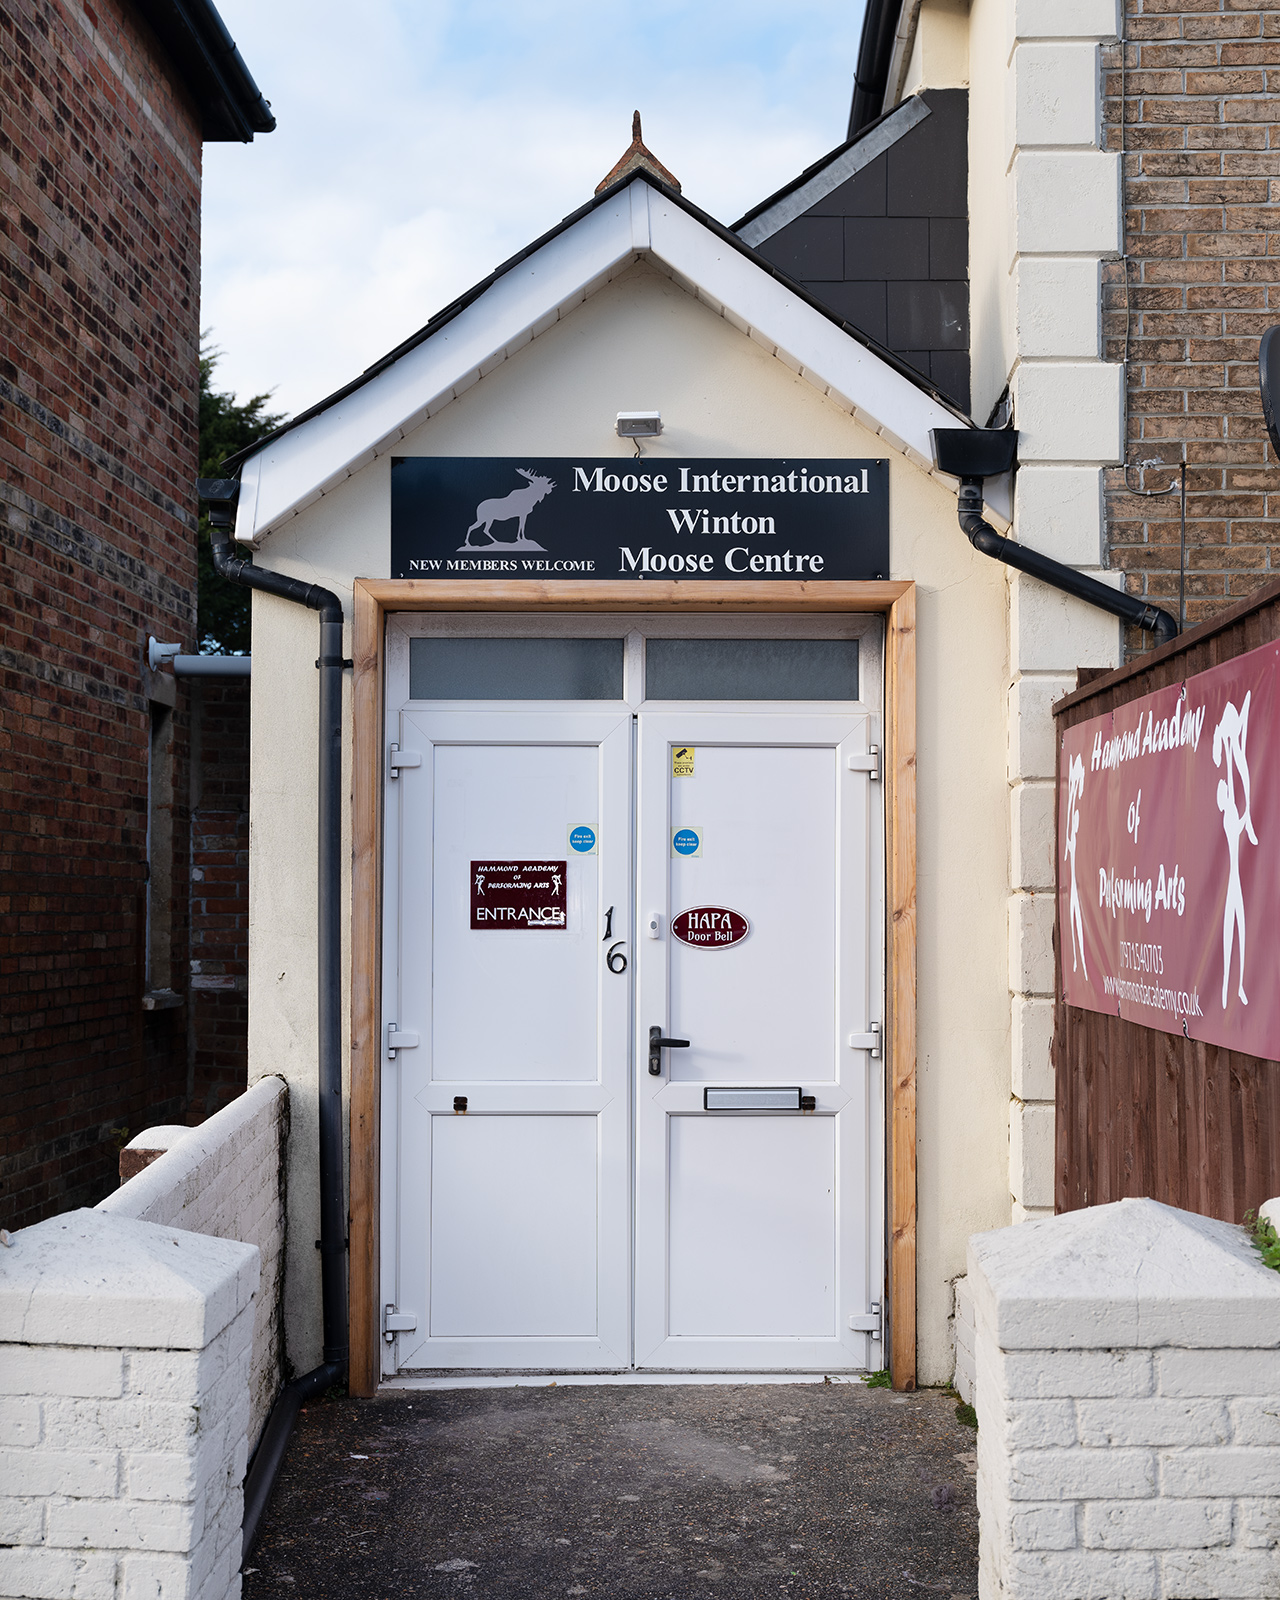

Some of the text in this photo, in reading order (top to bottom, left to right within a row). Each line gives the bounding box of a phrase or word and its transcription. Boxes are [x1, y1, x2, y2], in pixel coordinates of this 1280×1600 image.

[572, 466, 870, 494] Moose International
[666, 508, 777, 535] Winton
[409, 559, 596, 572] NEW MEMBERS WELCOME
[618, 546, 824, 573] Moose Centre
[1141, 698, 1206, 753] Academy
[1127, 788, 1142, 844] of
[1155, 863, 1186, 917] Arts
[476, 906, 561, 921] ENTRANCE
[687, 912, 733, 930] HAPA
[687, 930, 734, 942] Door Bell
